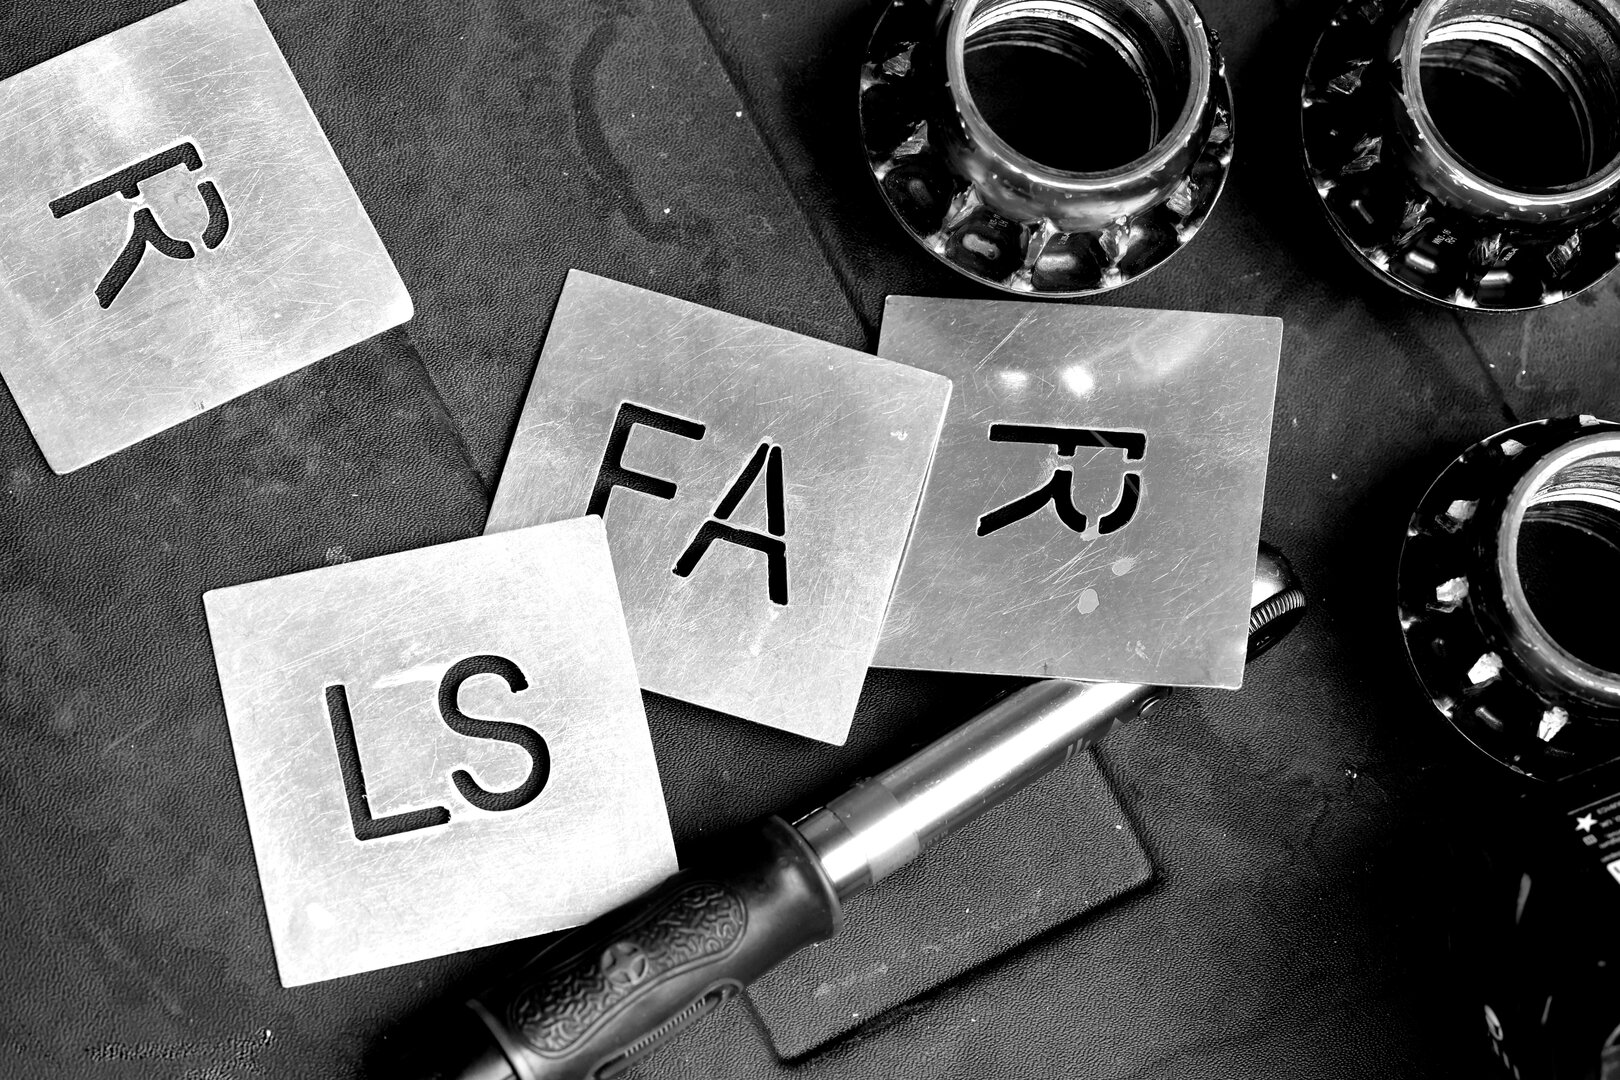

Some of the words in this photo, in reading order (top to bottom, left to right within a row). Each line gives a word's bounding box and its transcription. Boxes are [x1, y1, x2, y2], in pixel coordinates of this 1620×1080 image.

[48, 141, 230, 309] R
[584, 402, 789, 606] FA
[976, 423, 1147, 537] R
[324, 654, 551, 842] LS
